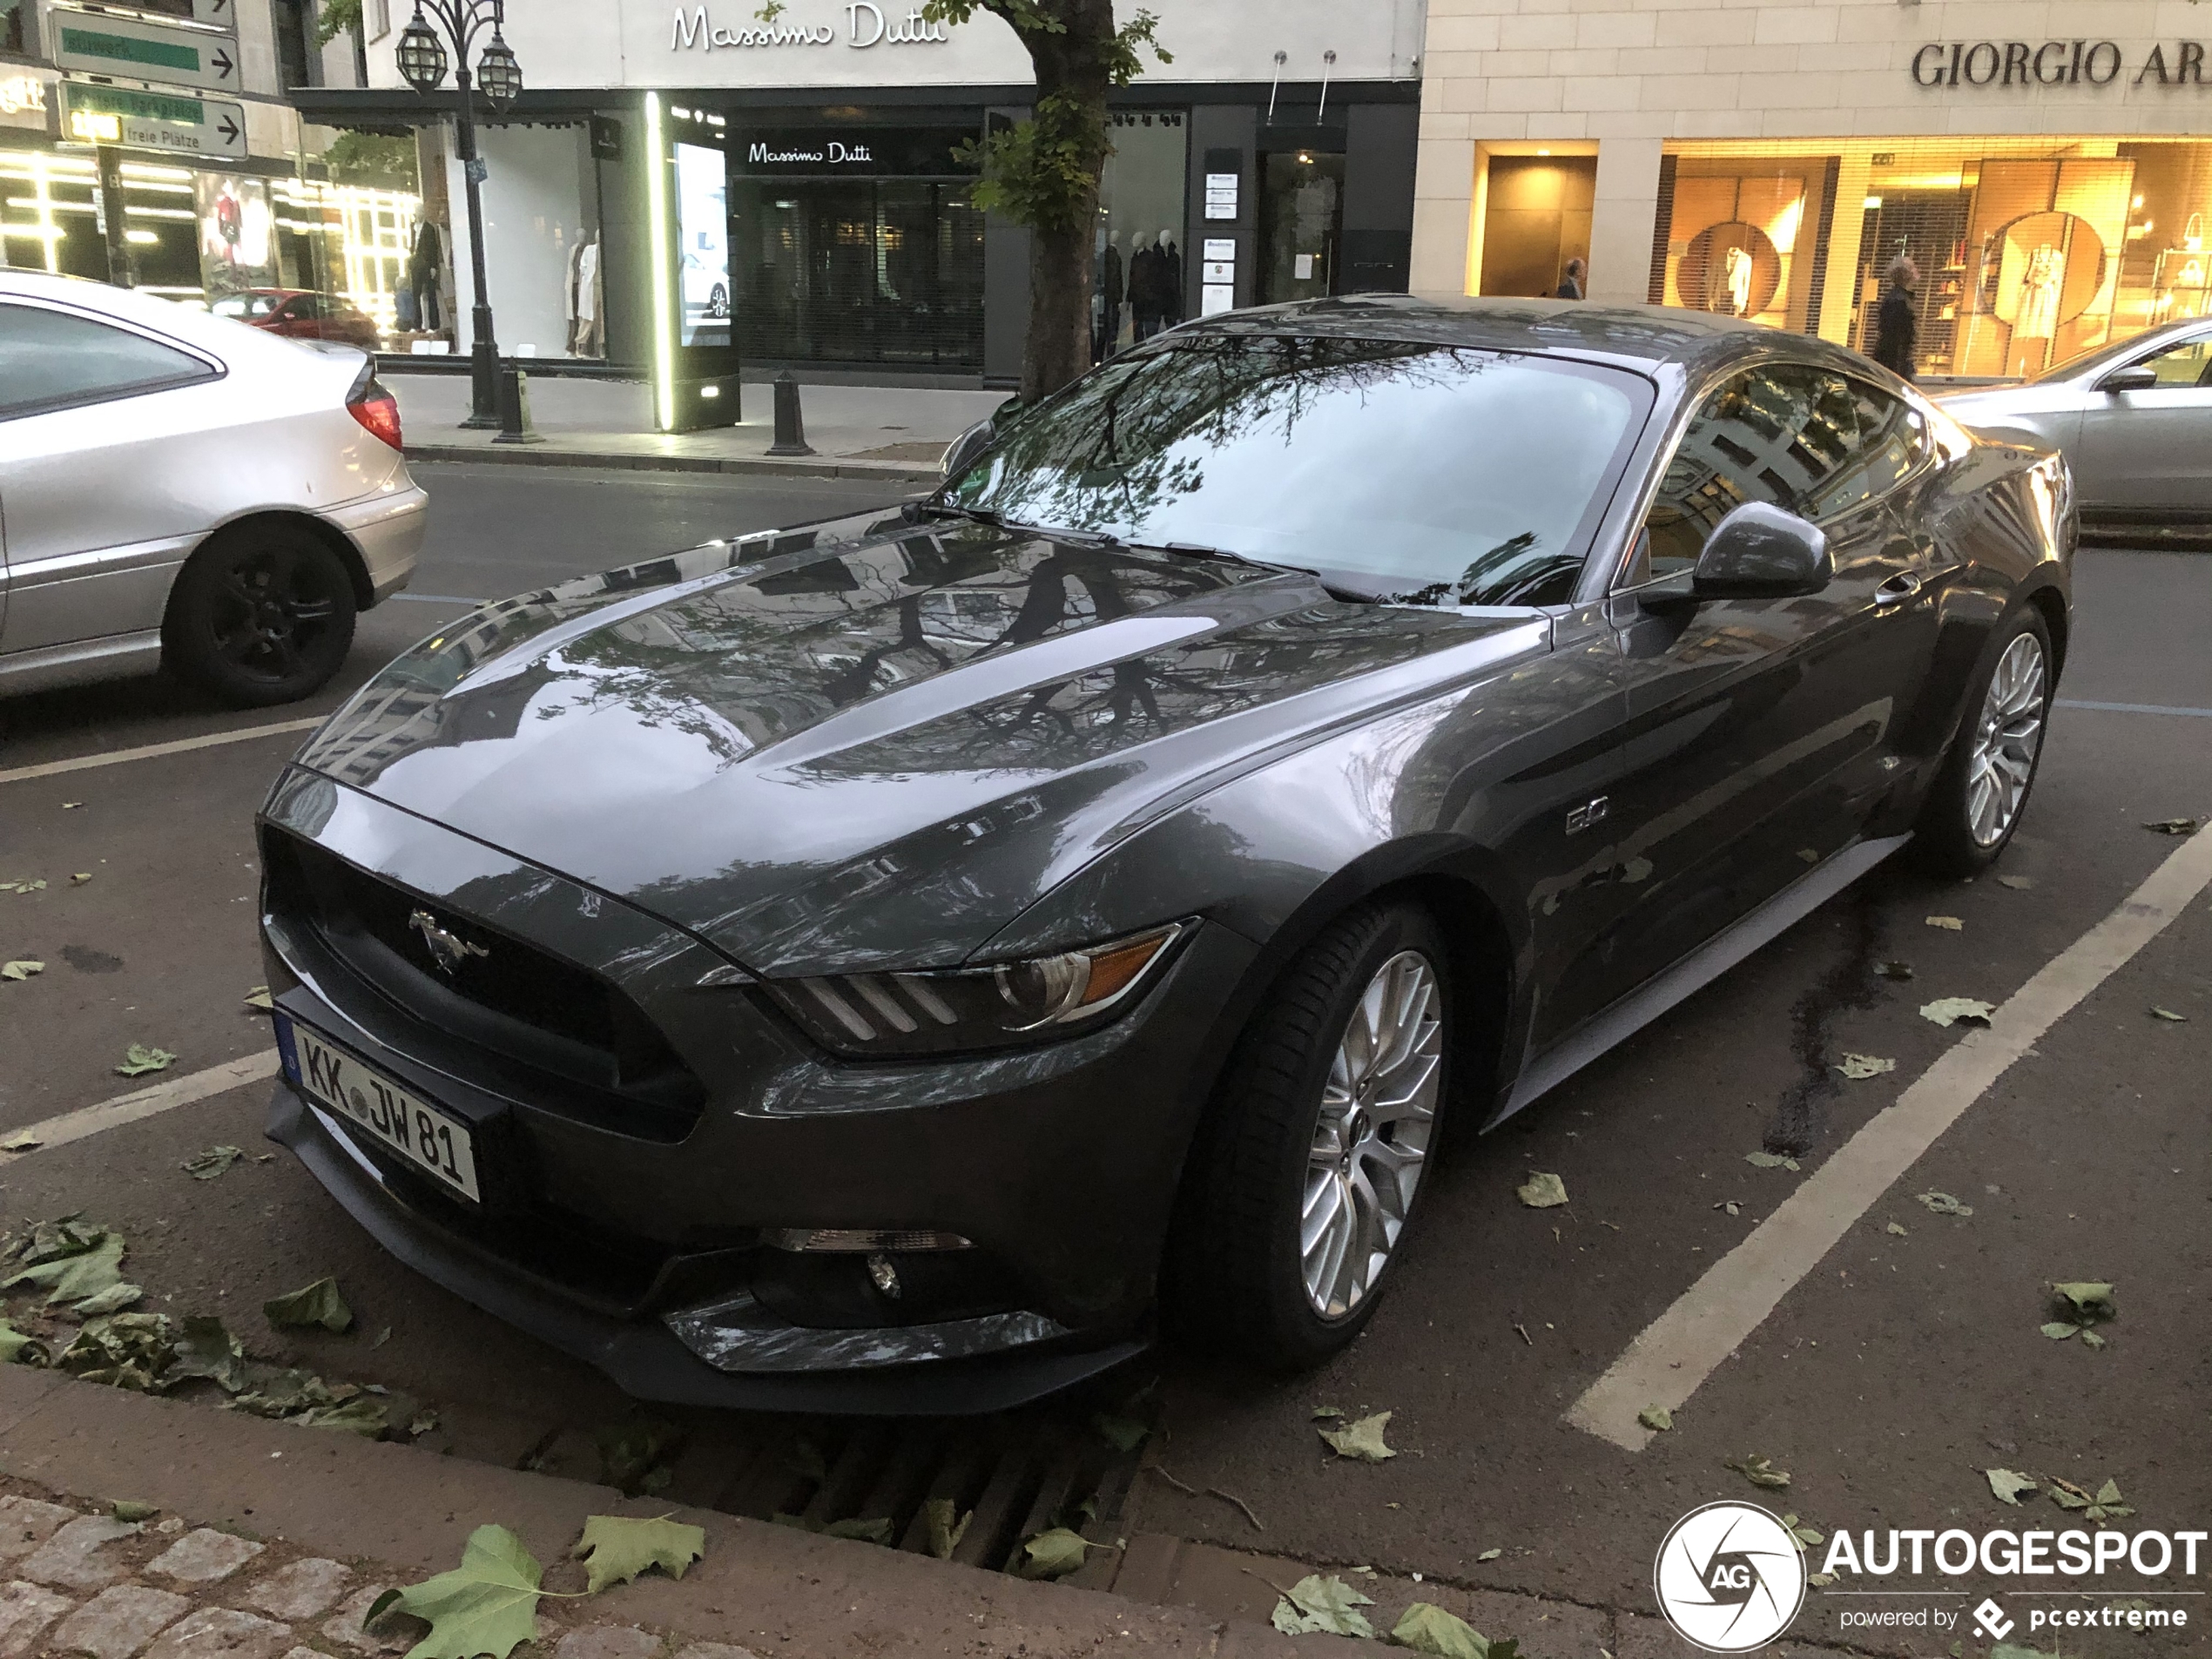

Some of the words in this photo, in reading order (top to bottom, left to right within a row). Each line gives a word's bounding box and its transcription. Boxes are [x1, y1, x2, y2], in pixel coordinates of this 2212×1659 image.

[671, 4, 834, 51] Massimo
[846, 2, 948, 48] Dutti
[1912, 41, 2121, 86] GIORGIO
[127, 125, 158, 144] freie
[162, 131, 199, 149] Plätze
[749, 142, 823, 164] Massimo
[826, 141, 873, 163] Dutti
[304, 1036, 350, 1111] KK
[369, 1078, 411, 1150] JW
[415, 1109, 464, 1185] 81
